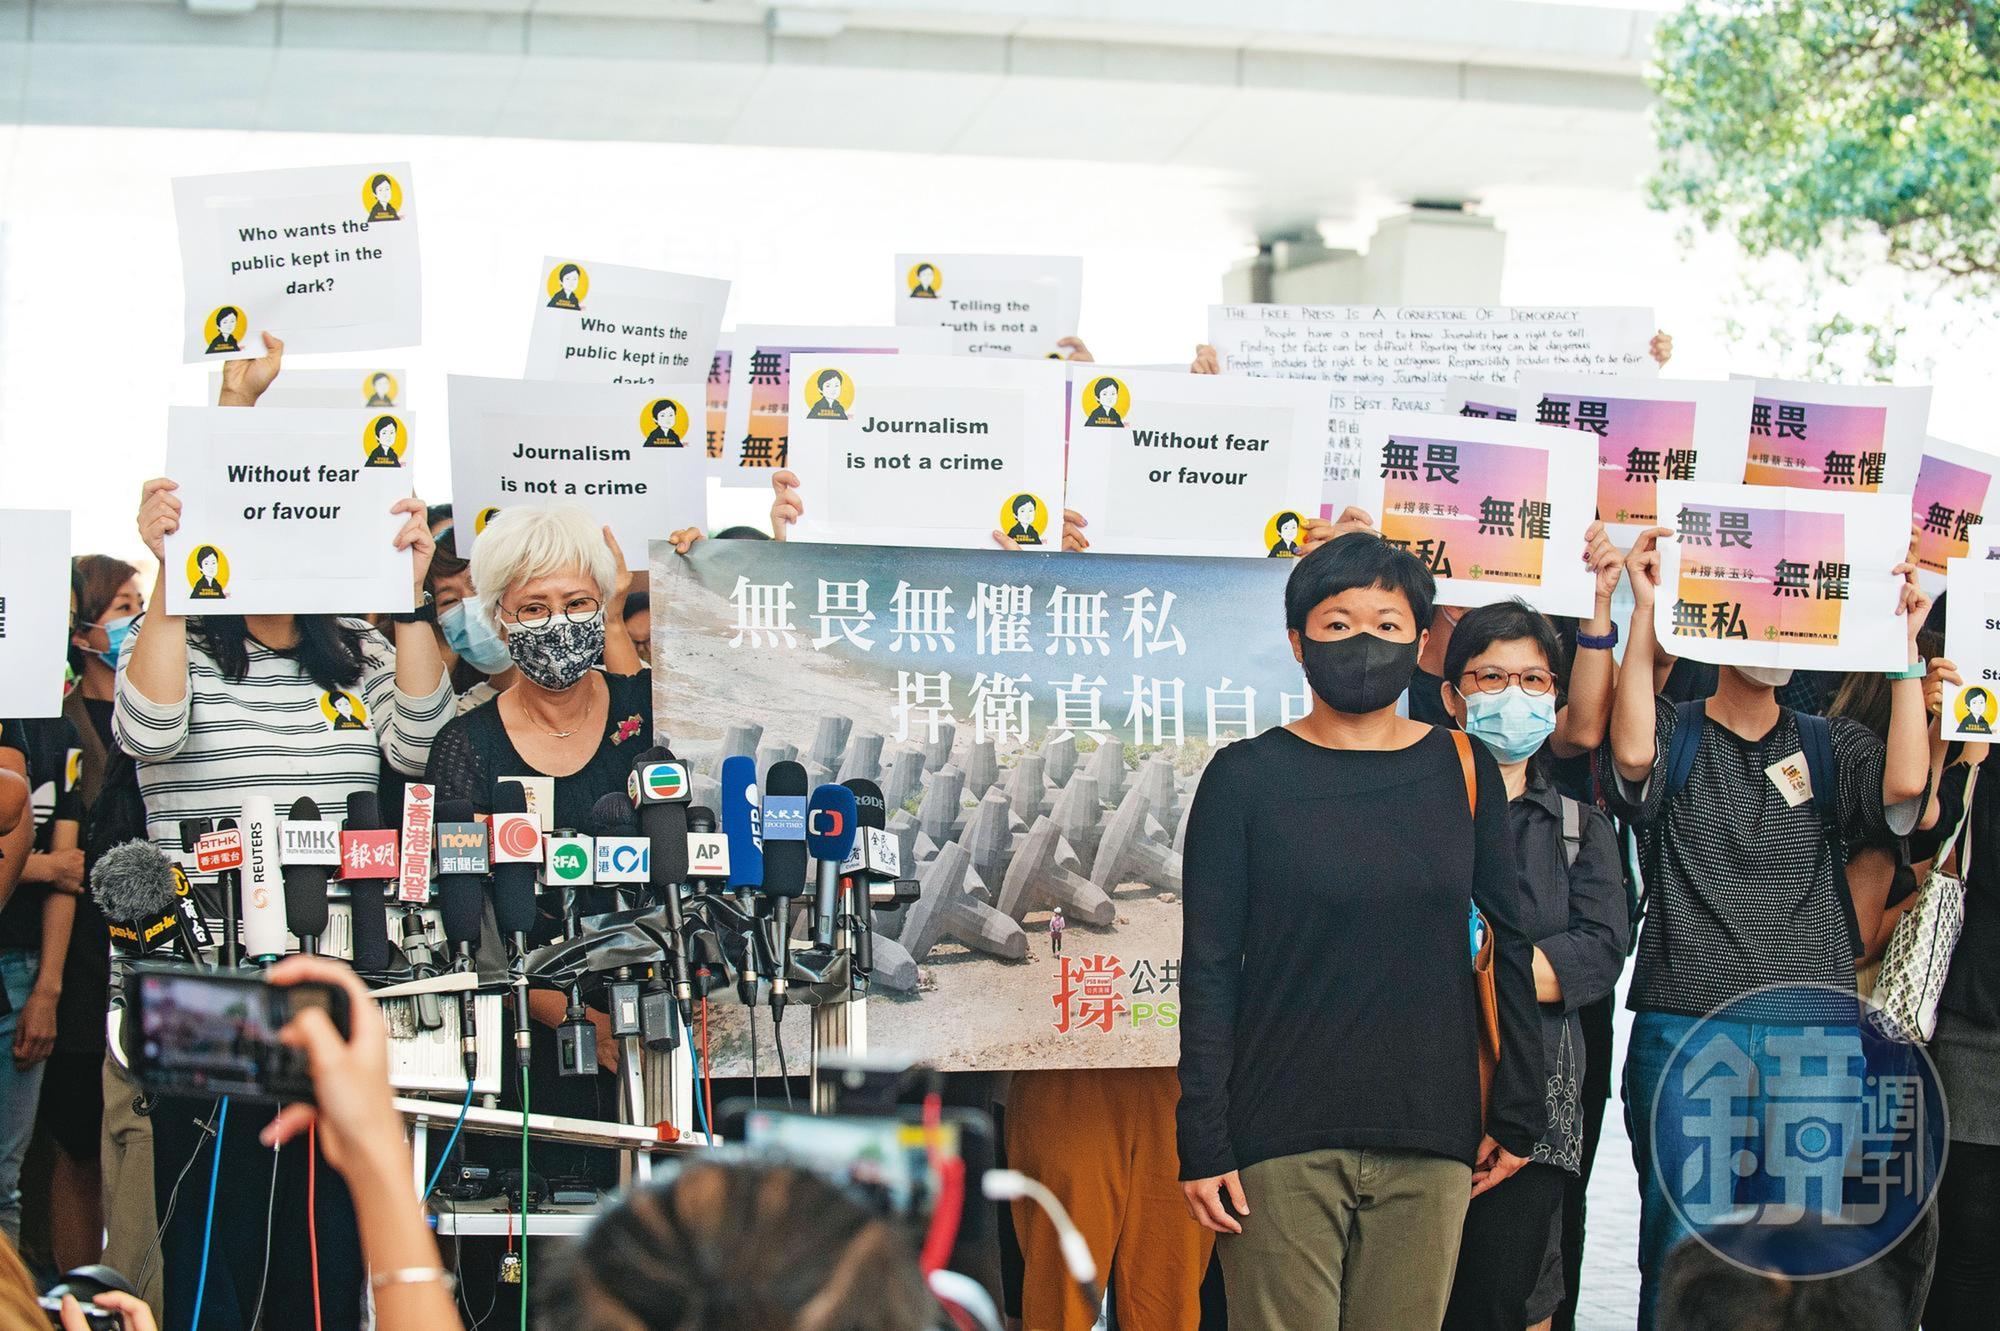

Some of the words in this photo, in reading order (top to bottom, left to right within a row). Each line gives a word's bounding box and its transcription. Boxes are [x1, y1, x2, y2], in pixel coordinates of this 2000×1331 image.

[239, 227, 277, 242] Who
[284, 222, 336, 238] wants
[342, 219, 370, 233] the
[231, 255, 286, 275] public
[291, 250, 330, 268] kept
[335, 249, 350, 263] in
[356, 246, 383, 261] the
[286, 278, 335, 295] dark?
[950, 300, 1001, 314] Telling
[1007, 301, 1030, 312] the
[1224, 307, 1247, 319] THE
[1261, 307, 1290, 319] FREE
[1302, 306, 1335, 320] PRESS
[1373, 307, 1386, 320] A
[1397, 306, 1467, 320] CORNERSTONE
[1510, 307, 1579, 321] DEMOCRACY
[581, 317, 616, 334] Who
[622, 323, 665, 338] wants
[669, 326, 688, 340] the
[941, 321, 978, 332] uth
[984, 321, 996, 332] is
[1001, 322, 1024, 333] not
[1030, 324, 1038, 333] a
[1308, 326, 1332, 338] have
[565, 345, 617, 361] public
[622, 348, 656, 366] kept
[659, 352, 669, 365] in
[673, 353, 689, 366] the
[1240, 340, 1275, 356] Finding
[1393, 369, 1448, 384] Journalists
[862, 416, 989, 434] Journalism
[1535, 397, 1609, 437] 無畏
[1750, 403, 1808, 441] 無畏
[1132, 430, 1219, 450] Without
[1225, 434, 1269, 451] fear
[513, 443, 631, 461] Journalism
[847, 452, 866, 469] is
[874, 453, 910, 470] not
[919, 457, 932, 470] a
[940, 453, 1004, 471] crime
[1380, 439, 1460, 485] 無畏
[1625, 446, 1697, 483] 無懼
[1822, 450, 1886, 486] 無懼
[227, 464, 311, 483] Without
[318, 464, 360, 483] fear
[1149, 469, 1172, 483] or
[1178, 467, 1248, 485] favour
[501, 476, 517, 492] is
[524, 479, 557, 494] not
[564, 482, 576, 495] a
[584, 480, 647, 495] crime
[243, 506, 266, 520] or
[272, 502, 341, 520] favour
[1394, 501, 1460, 517] #撐蔡玉玲
[1478, 495, 1552, 540] 無懼
[1676, 507, 1753, 549] 無畏
[1690, 564, 1754, 580] #撐蔡玉玲
[1773, 558, 1851, 600] 無懼
[728, 575, 1189, 658] 無畏無懼無私
[1672, 598, 1749, 640] 無私
[1982, 668, 2000, 680] St
[200, 835, 237, 850] RTHK
[285, 830, 336, 848] TMHK
[441, 833, 484, 848] now
[200, 852, 240, 866] 香港電台
[251, 822, 264, 883] REUTERS
[403, 803, 432, 901] 香港高登
[598, 845, 610, 873] 香港
[696, 844, 720, 859] AP
[442, 856, 485, 872] 新聞台
[553, 855, 580, 868] RFA
[1053, 954, 1126, 1034] 撐
[1131, 1002, 1179, 1028] PS
